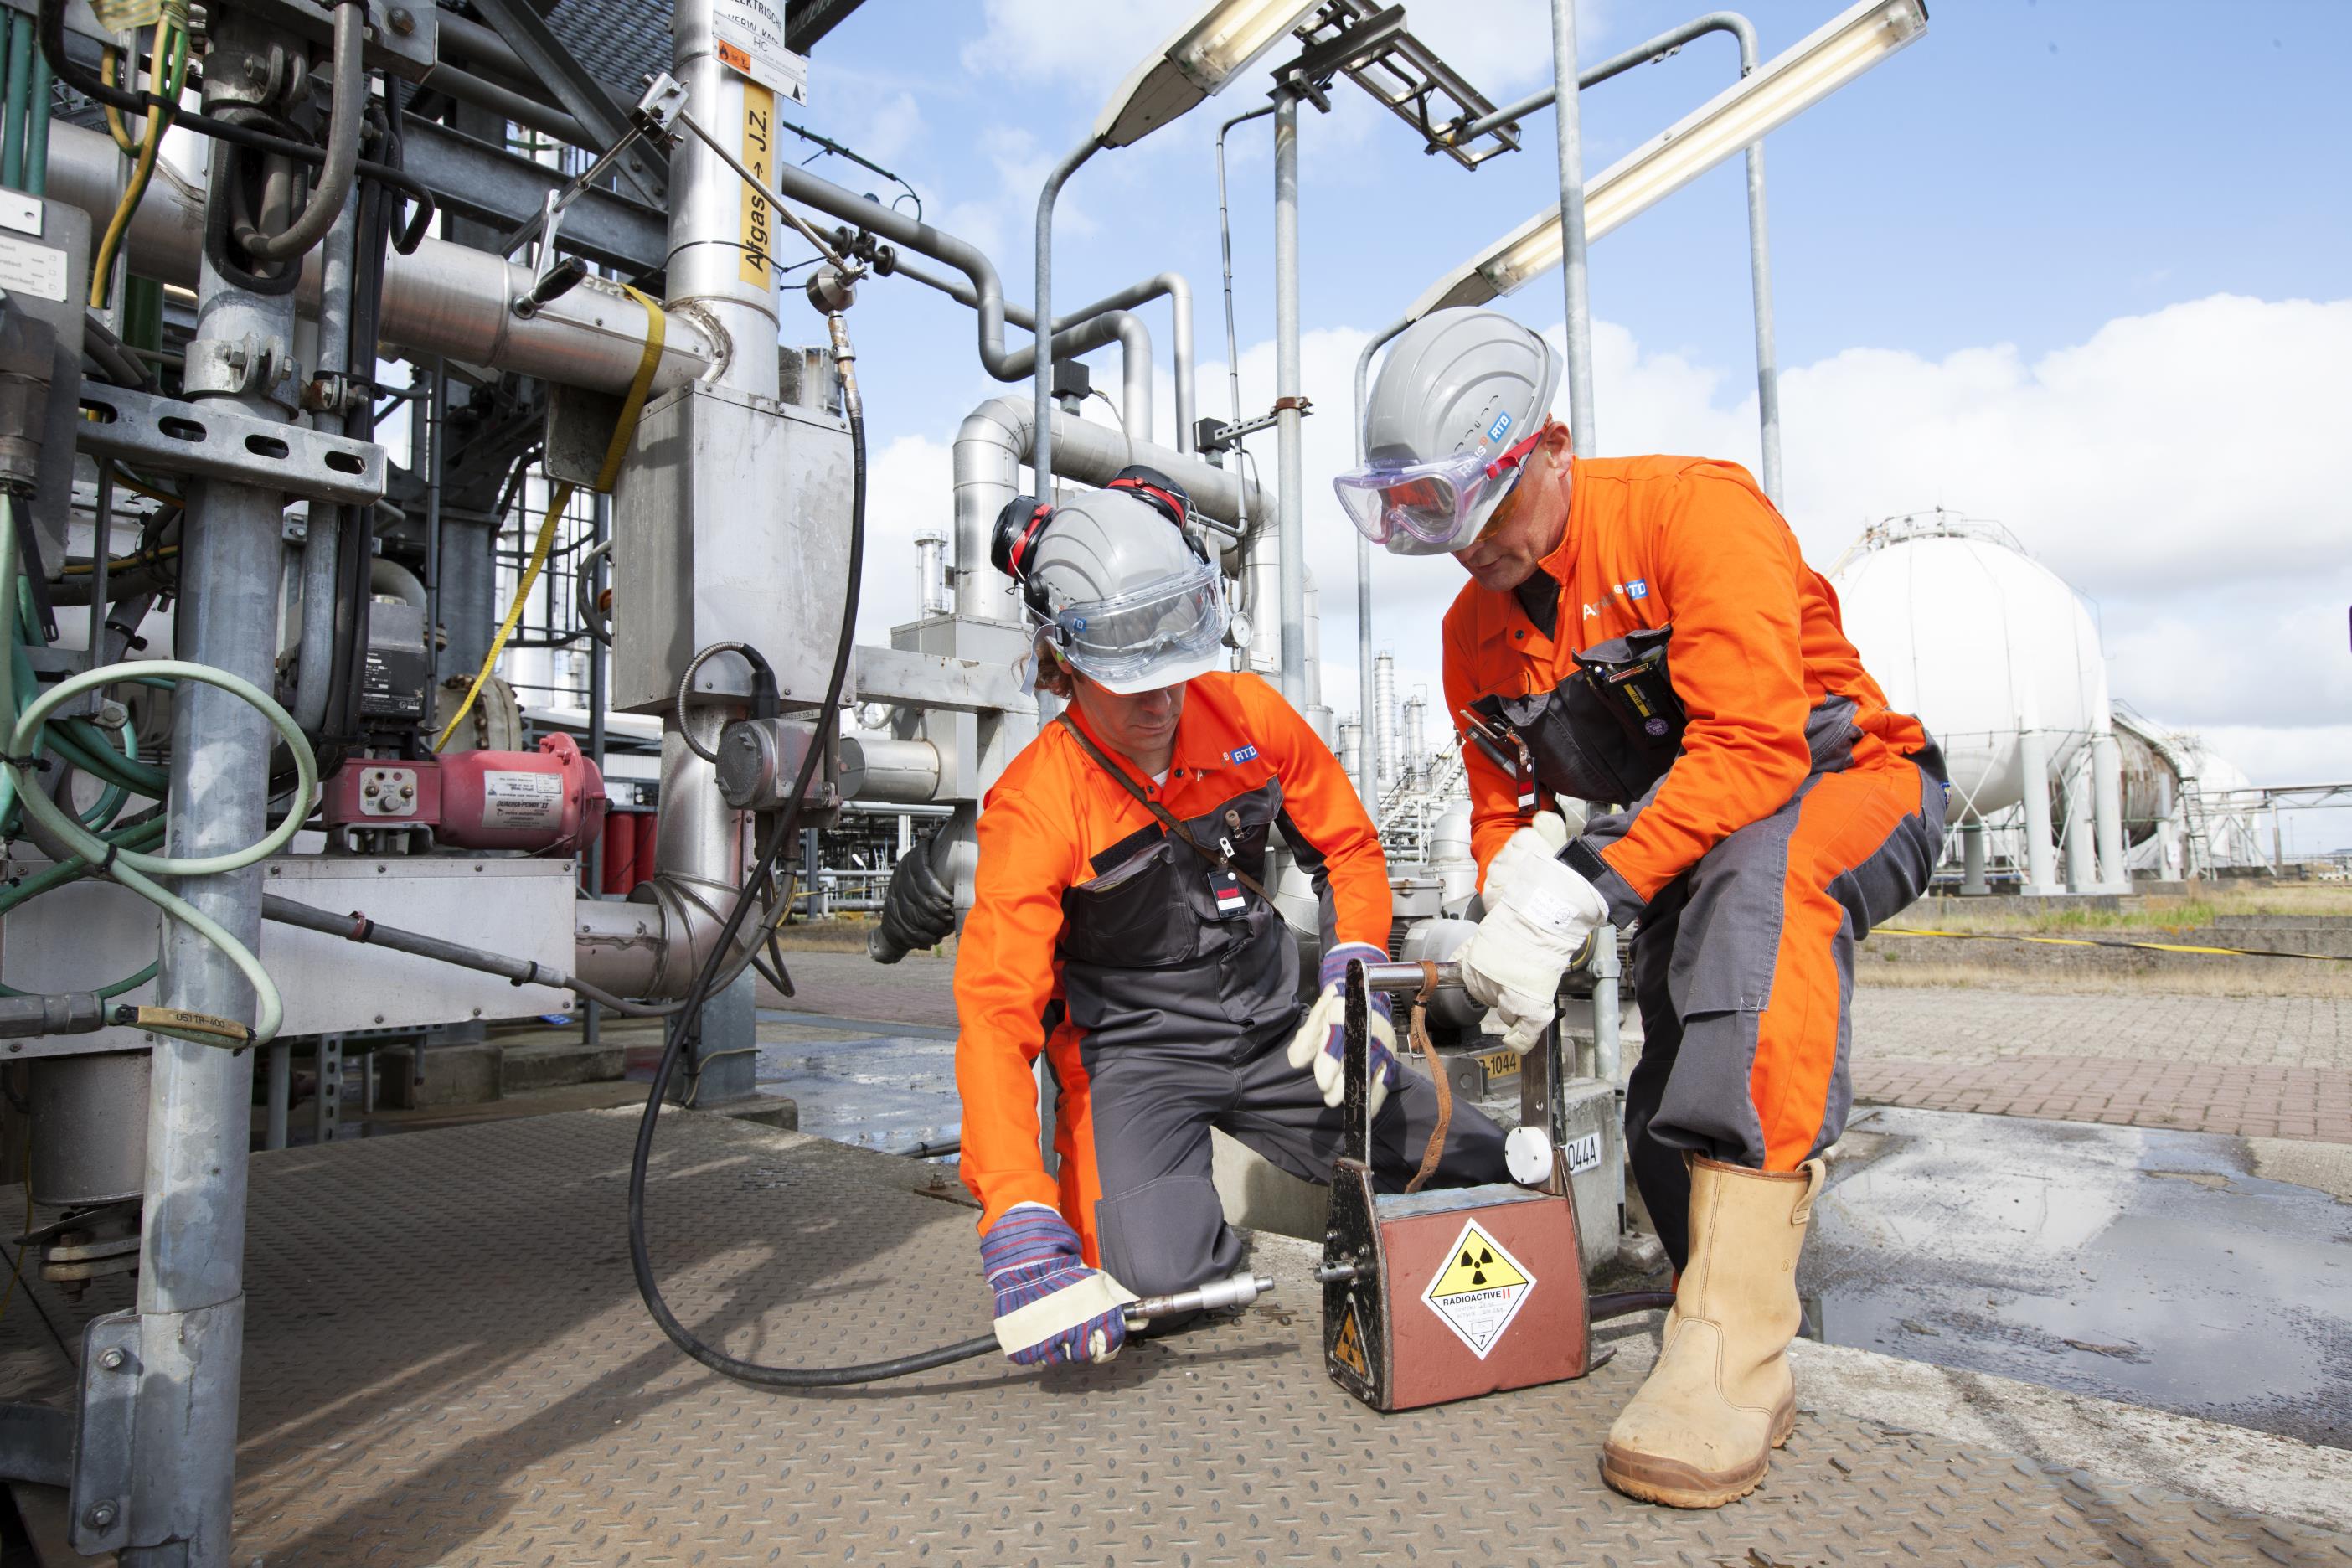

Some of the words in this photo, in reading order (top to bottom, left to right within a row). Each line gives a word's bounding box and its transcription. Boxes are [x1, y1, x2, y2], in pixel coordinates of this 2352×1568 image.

[730, 0, 782, 34] KTRISCHE
[754, 36, 769, 52] HC
[749, 110, 766, 152] J.Z.
[745, 194, 768, 273] Afgas
[1491, 415, 1509, 439] RTD
[1626, 582, 1647, 596] TD
[1234, 745, 1256, 762] RTD
[1564, 1136, 1597, 1171] 044A
[1442, 1290, 1502, 1307] RADIOACTIVE
[1479, 1334, 1486, 1345] 7
